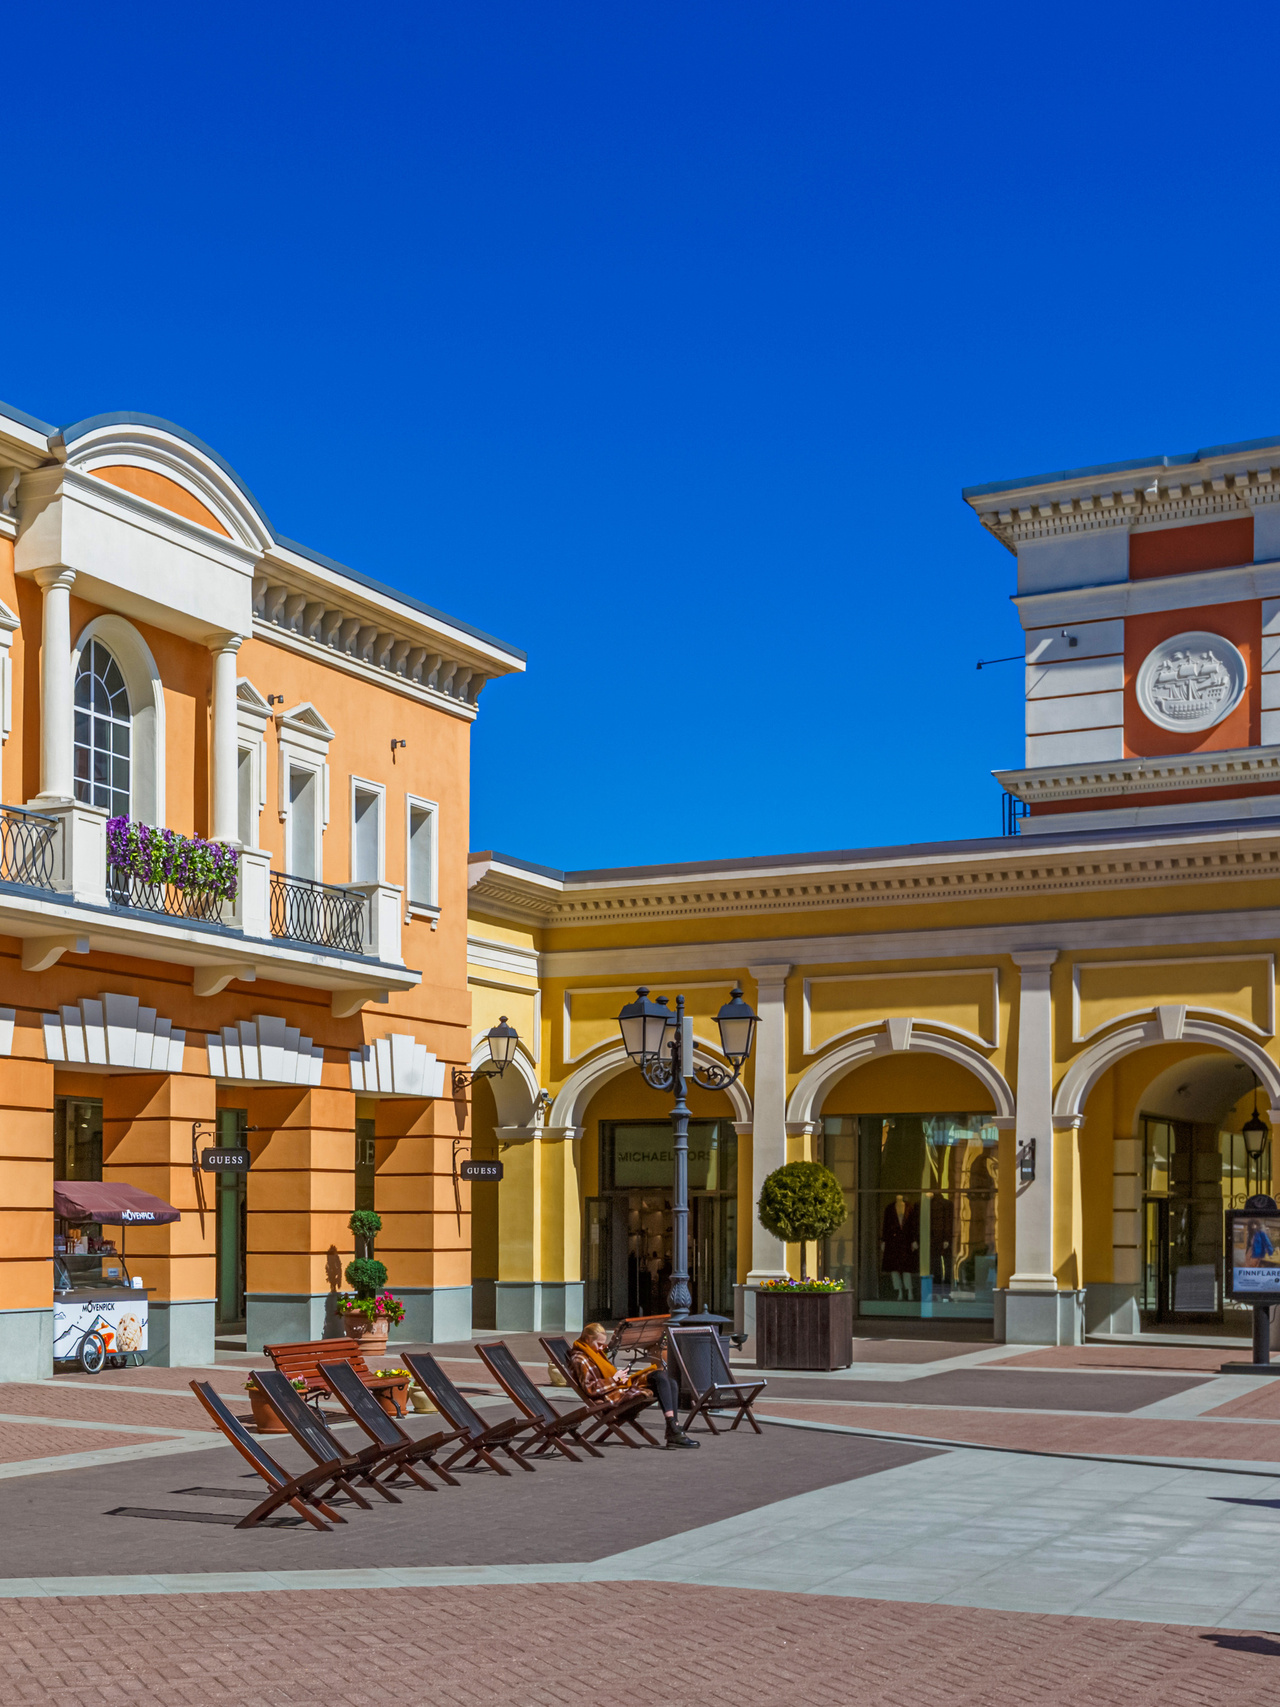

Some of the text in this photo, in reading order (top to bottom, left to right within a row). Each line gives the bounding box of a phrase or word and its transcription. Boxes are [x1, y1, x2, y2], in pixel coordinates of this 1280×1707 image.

[208, 1155, 243, 1165] GUESS
[618, 1151, 715, 1162] MICHAEL ORS
[466, 1167, 497, 1175] GUESS
